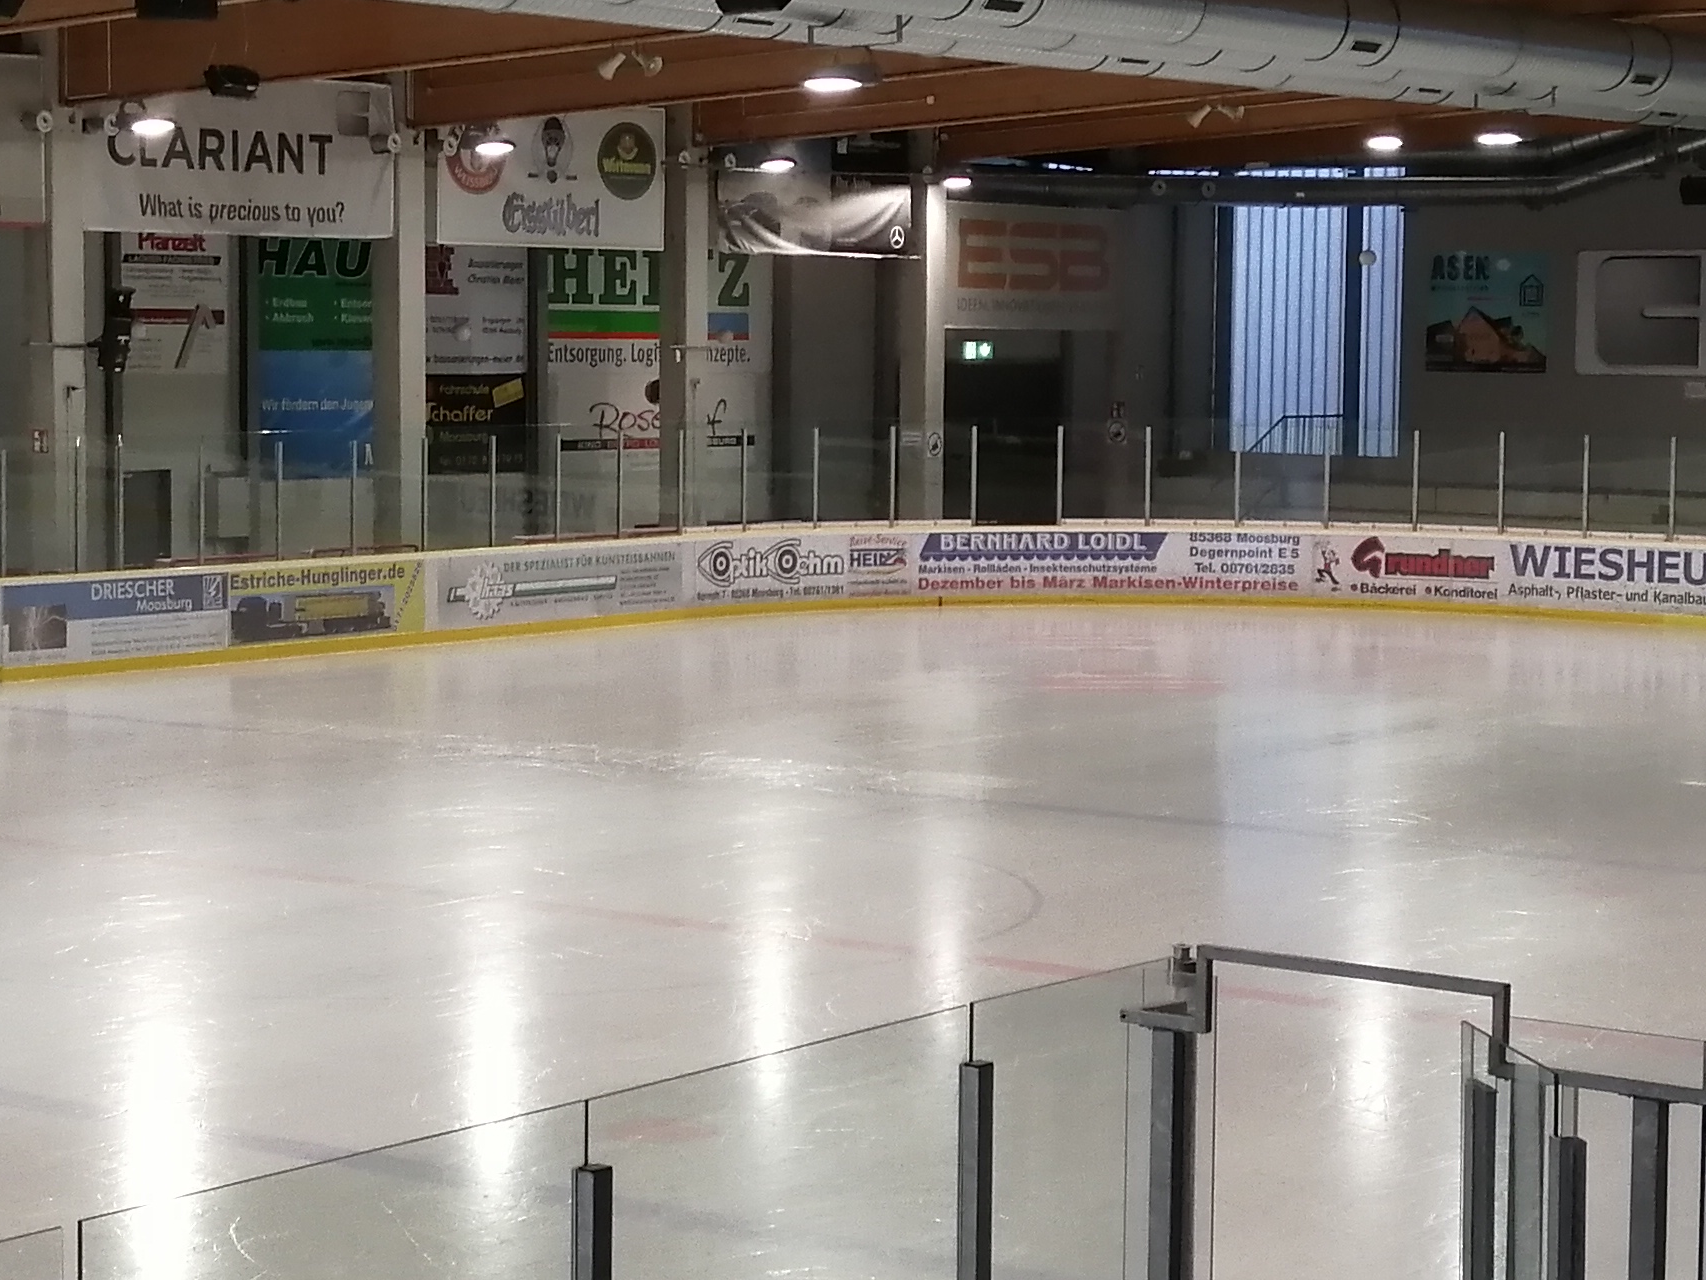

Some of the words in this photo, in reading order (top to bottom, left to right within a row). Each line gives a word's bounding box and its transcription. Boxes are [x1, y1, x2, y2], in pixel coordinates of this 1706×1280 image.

[106, 124, 334, 177] CLARIANT
[139, 193, 185, 219] What
[188, 199, 204, 219] is
[208, 200, 283, 226] precious
[285, 201, 305, 222] to
[307, 200, 345, 228] you?
[547, 343, 627, 368] Entsorgung.
[630, 343, 661, 368] Logi
[940, 531, 1073, 552] BERNHARD
[1079, 531, 1146, 552] LOIDL
[1236, 532, 1301, 546] Moosburg
[1188, 546, 1275, 560] Degernpoint
[503, 561, 522, 573] DER
[523, 557, 574, 571] SPEZIALIST
[575, 554, 594, 568] FÜR
[701, 543, 769, 584] Optik
[918, 563, 966, 575] Markisen
[1029, 563, 1158, 576] Insektenschutzsysteme
[1194, 562, 1217, 575] Tel.
[230, 563, 406, 592] Estriche-Hunglinger.de
[917, 576, 1004, 592] Dezember
[1010, 576, 1036, 591] bis
[1041, 575, 1085, 591] März
[1092, 576, 1299, 592] Markisen-Winterpreise
[90, 576, 176, 603] DRIESCHER
[1359, 582, 1417, 597] Bäckerei
[1433, 586, 1499, 601] Konditorei
[1625, 589, 1649, 603] und
[136, 596, 193, 614] Moosburg
